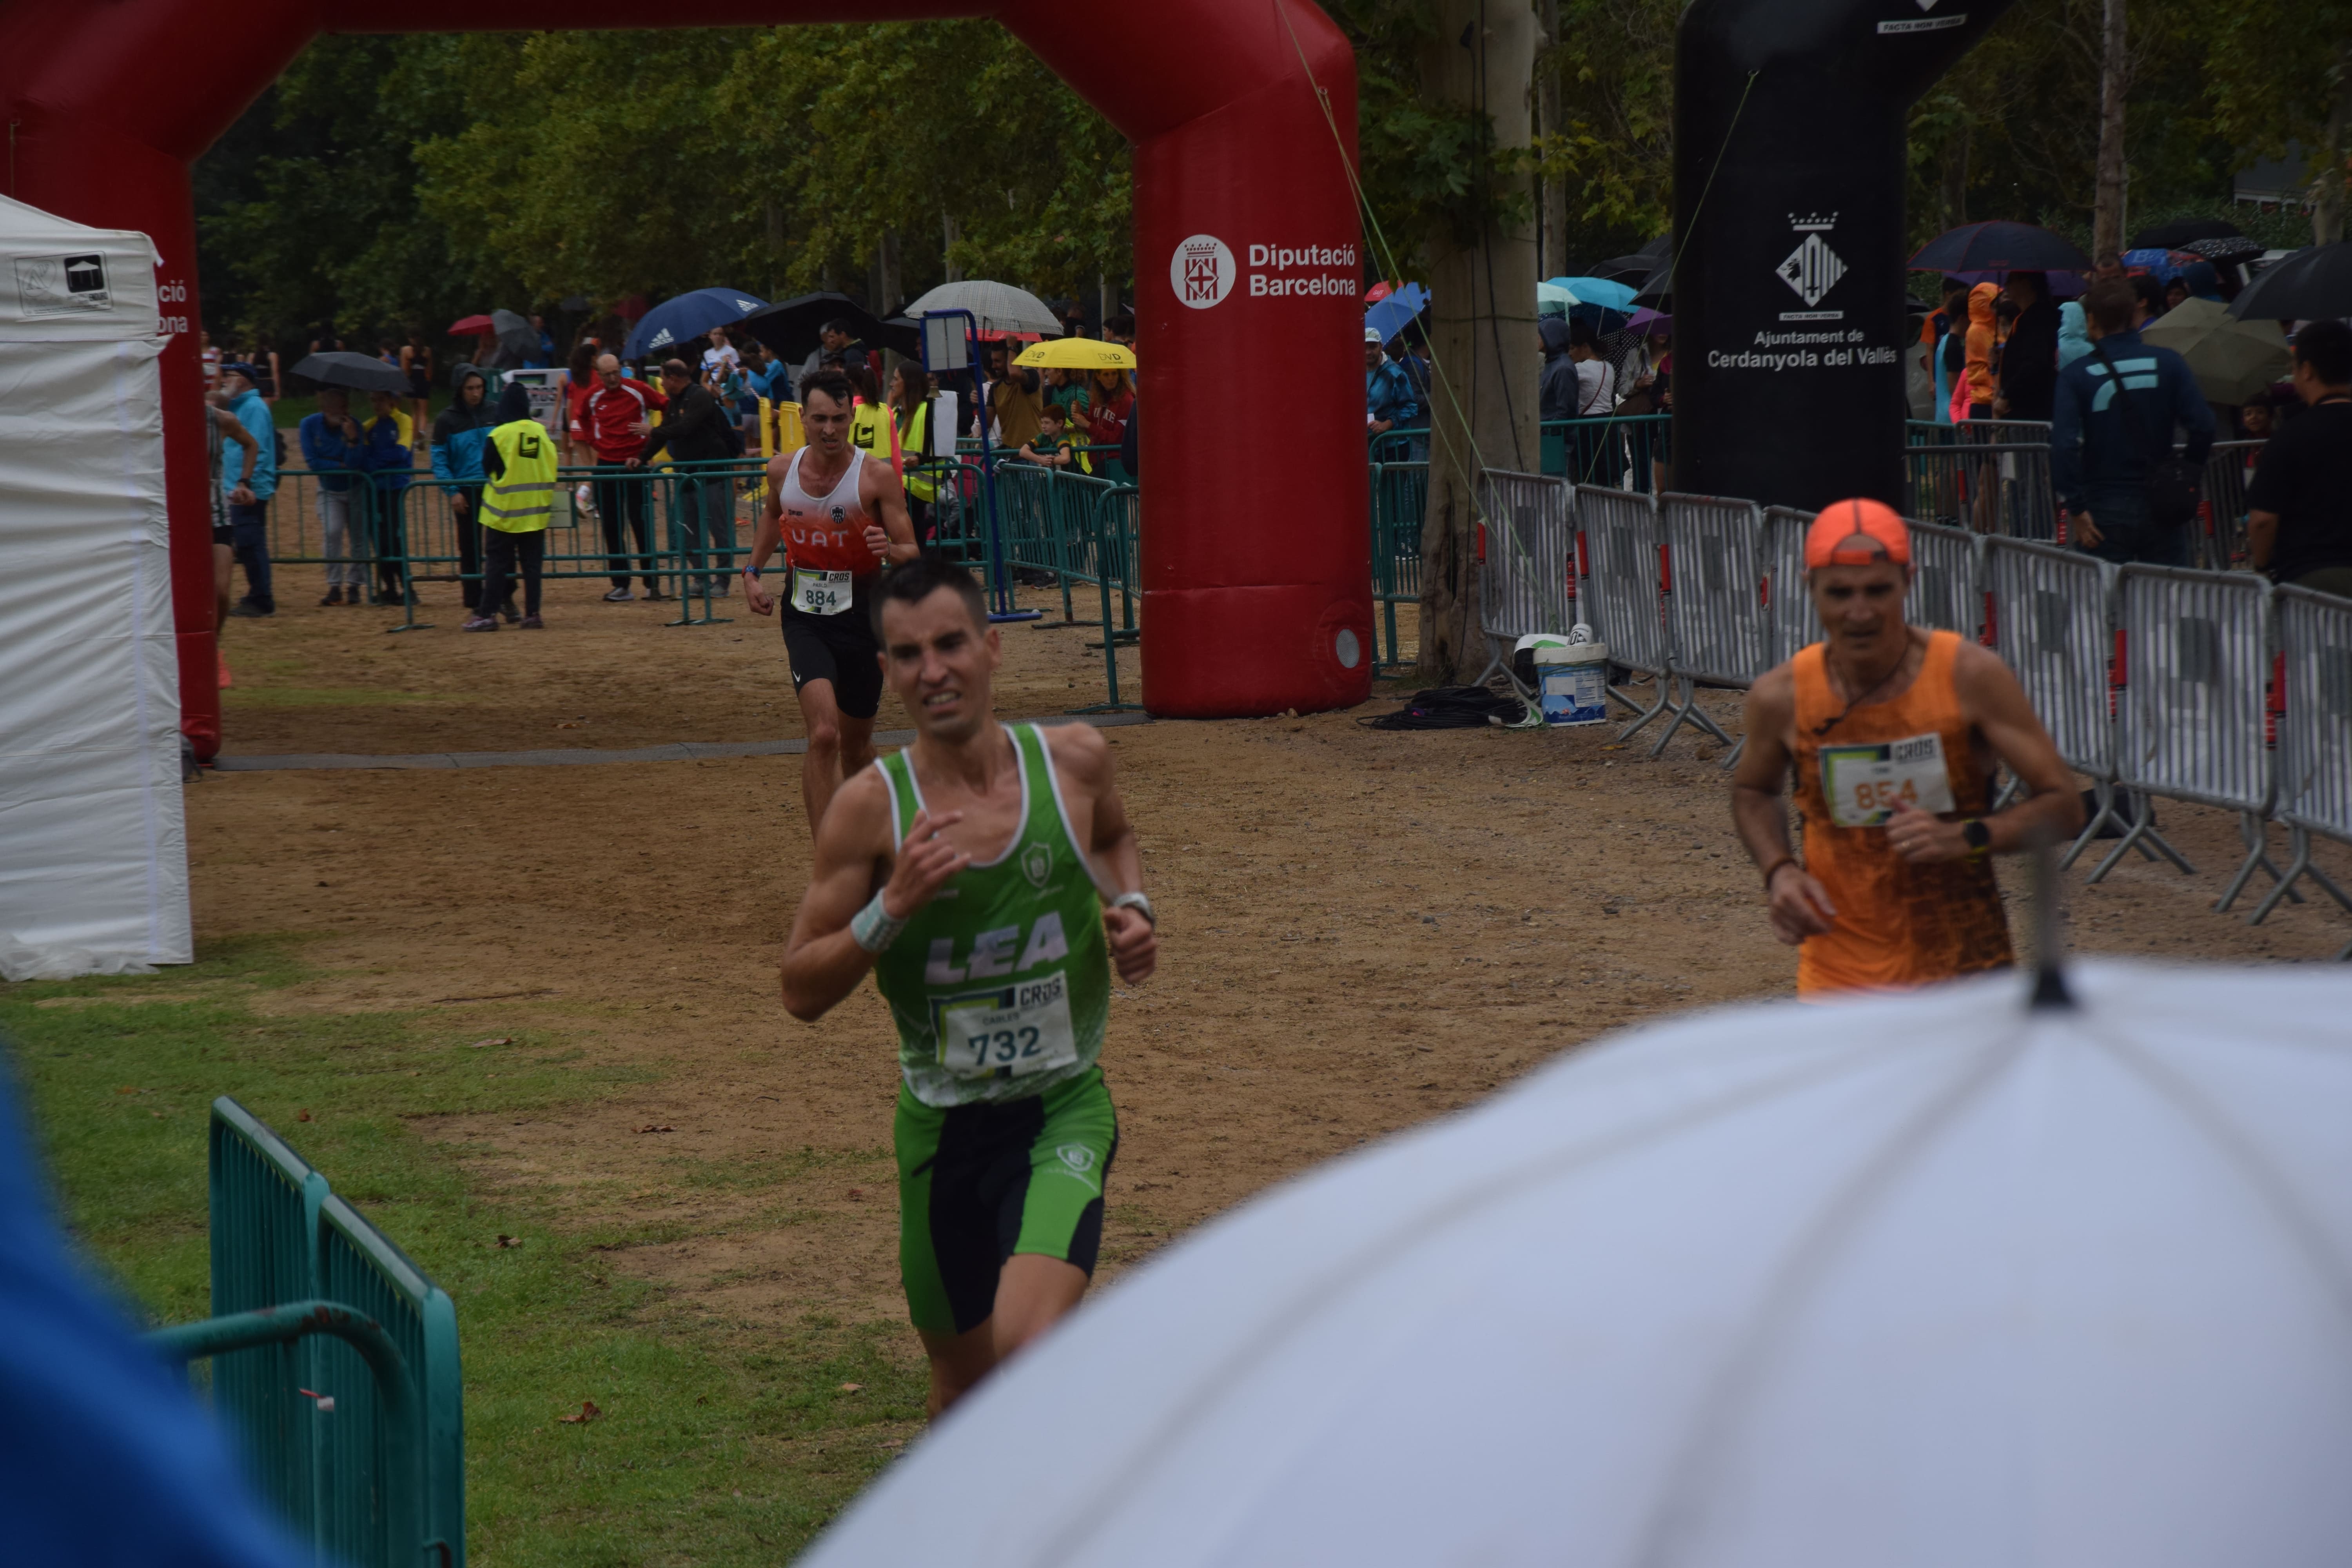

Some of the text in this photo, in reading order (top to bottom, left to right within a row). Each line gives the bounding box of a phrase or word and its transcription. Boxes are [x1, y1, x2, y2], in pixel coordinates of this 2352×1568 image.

[1249, 243, 1356, 270] Diputació
[158, 279, 187, 303] ció
[1250, 273, 1356, 297] Barcelona
[1754, 328, 1865, 348] Ajuntament de
[1708, 349, 1818, 372] Cerdanyola
[1823, 348, 1853, 366] del
[791, 529, 849, 548] UAT
[829, 573, 850, 581] CROS
[806, 590, 837, 606] 884
[924, 910, 1070, 985] LEA
[1020, 978, 1061, 1007] CROS
[968, 1025, 1041, 1066] 732
